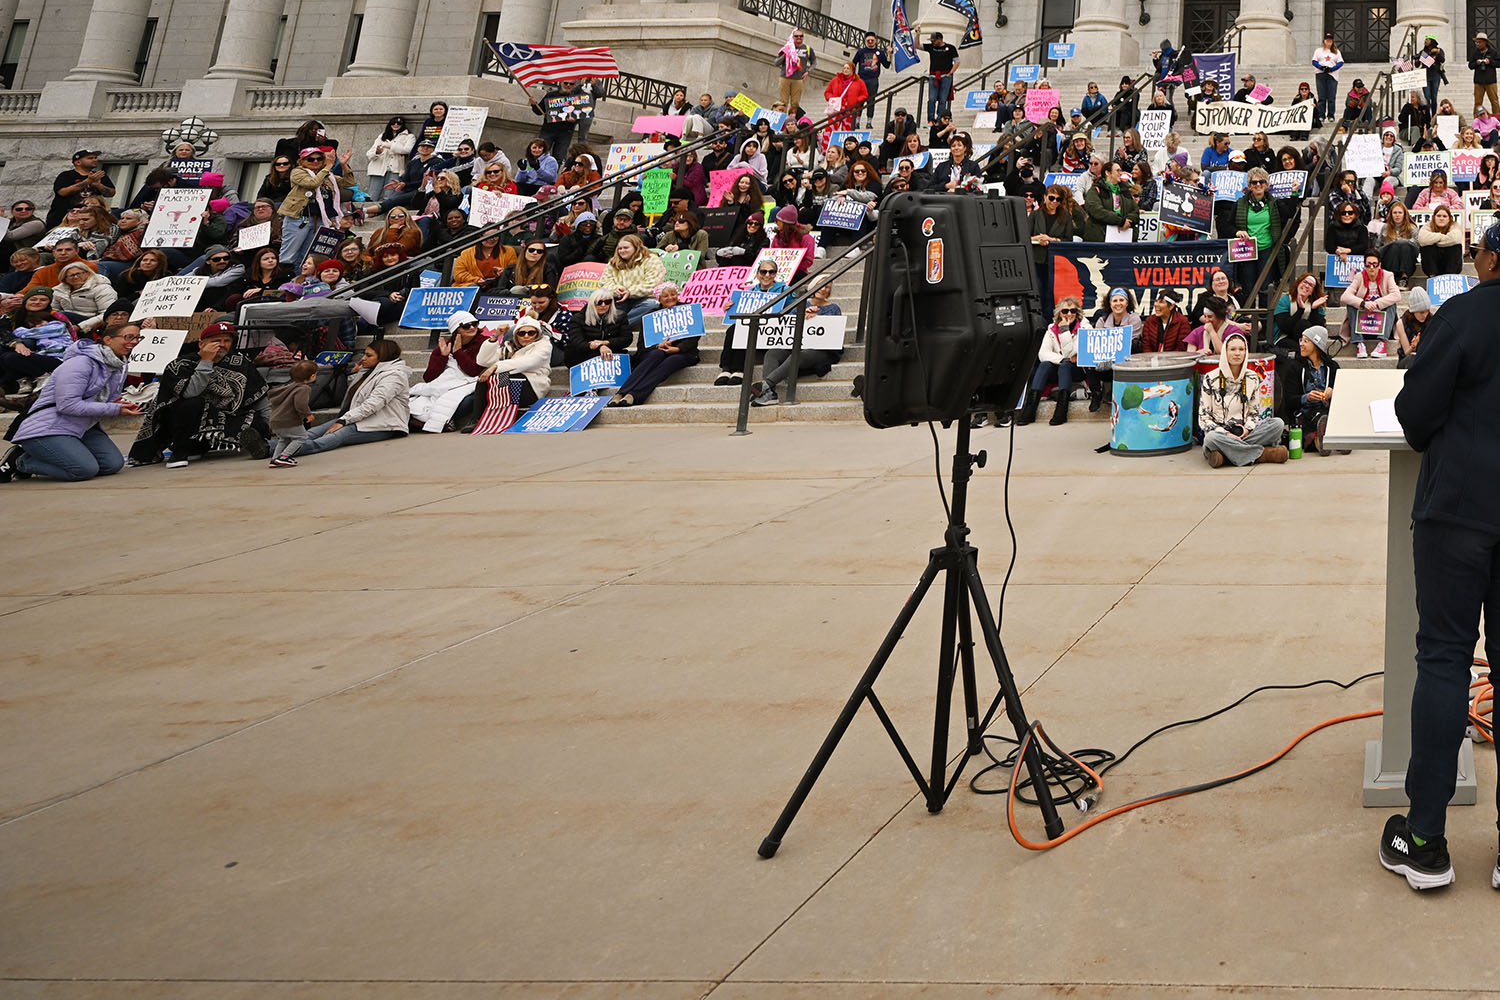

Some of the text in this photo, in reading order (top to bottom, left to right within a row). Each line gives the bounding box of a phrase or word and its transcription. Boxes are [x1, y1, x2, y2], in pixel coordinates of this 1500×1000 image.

[1220, 62, 1232, 101] HARR
[1141, 112, 1167, 121] MIND
[1198, 106, 1308, 128] STRONGER TOGETHER
[1141, 122, 1166, 131] YOUR
[611, 146, 641, 154] VOTING
[1416, 154, 1441, 162] MAKE
[1408, 162, 1449, 170] AMERICA
[1215, 176, 1244, 191] HARRIS
[1268, 172, 1304, 185] HARRIS
[824, 200, 864, 215] HARRIS
[828, 211, 860, 220] PRESIDENT
[1133, 254, 1223, 265] SALT LAKE CITY
[992, 258, 1023, 278] JBL
[691, 268, 726, 282] VOTE
[728, 267, 747, 280] FO
[166, 277, 204, 287] PROTECT
[1433, 279, 1464, 295] HARRIS
[682, 282, 745, 297] WOMEN'S
[421, 291, 465, 306] HARRIS
[487, 297, 514, 305] WHO'S
[427, 306, 455, 315] WALZ
[488, 308, 507, 316] OUR
[651, 305, 692, 319] UTAH FOR
[652, 311, 695, 333] HARRIS
[778, 316, 796, 326] WE
[662, 327, 688, 337] WALZ
[807, 326, 825, 336] GO
[151, 336, 168, 345] BE
[1087, 335, 1124, 353] HARRIS
[1094, 352, 1116, 361] WALZ
[580, 361, 622, 382] HARRIS
[589, 375, 615, 384] WALZ
[1391, 834, 1409, 855] HOKA
